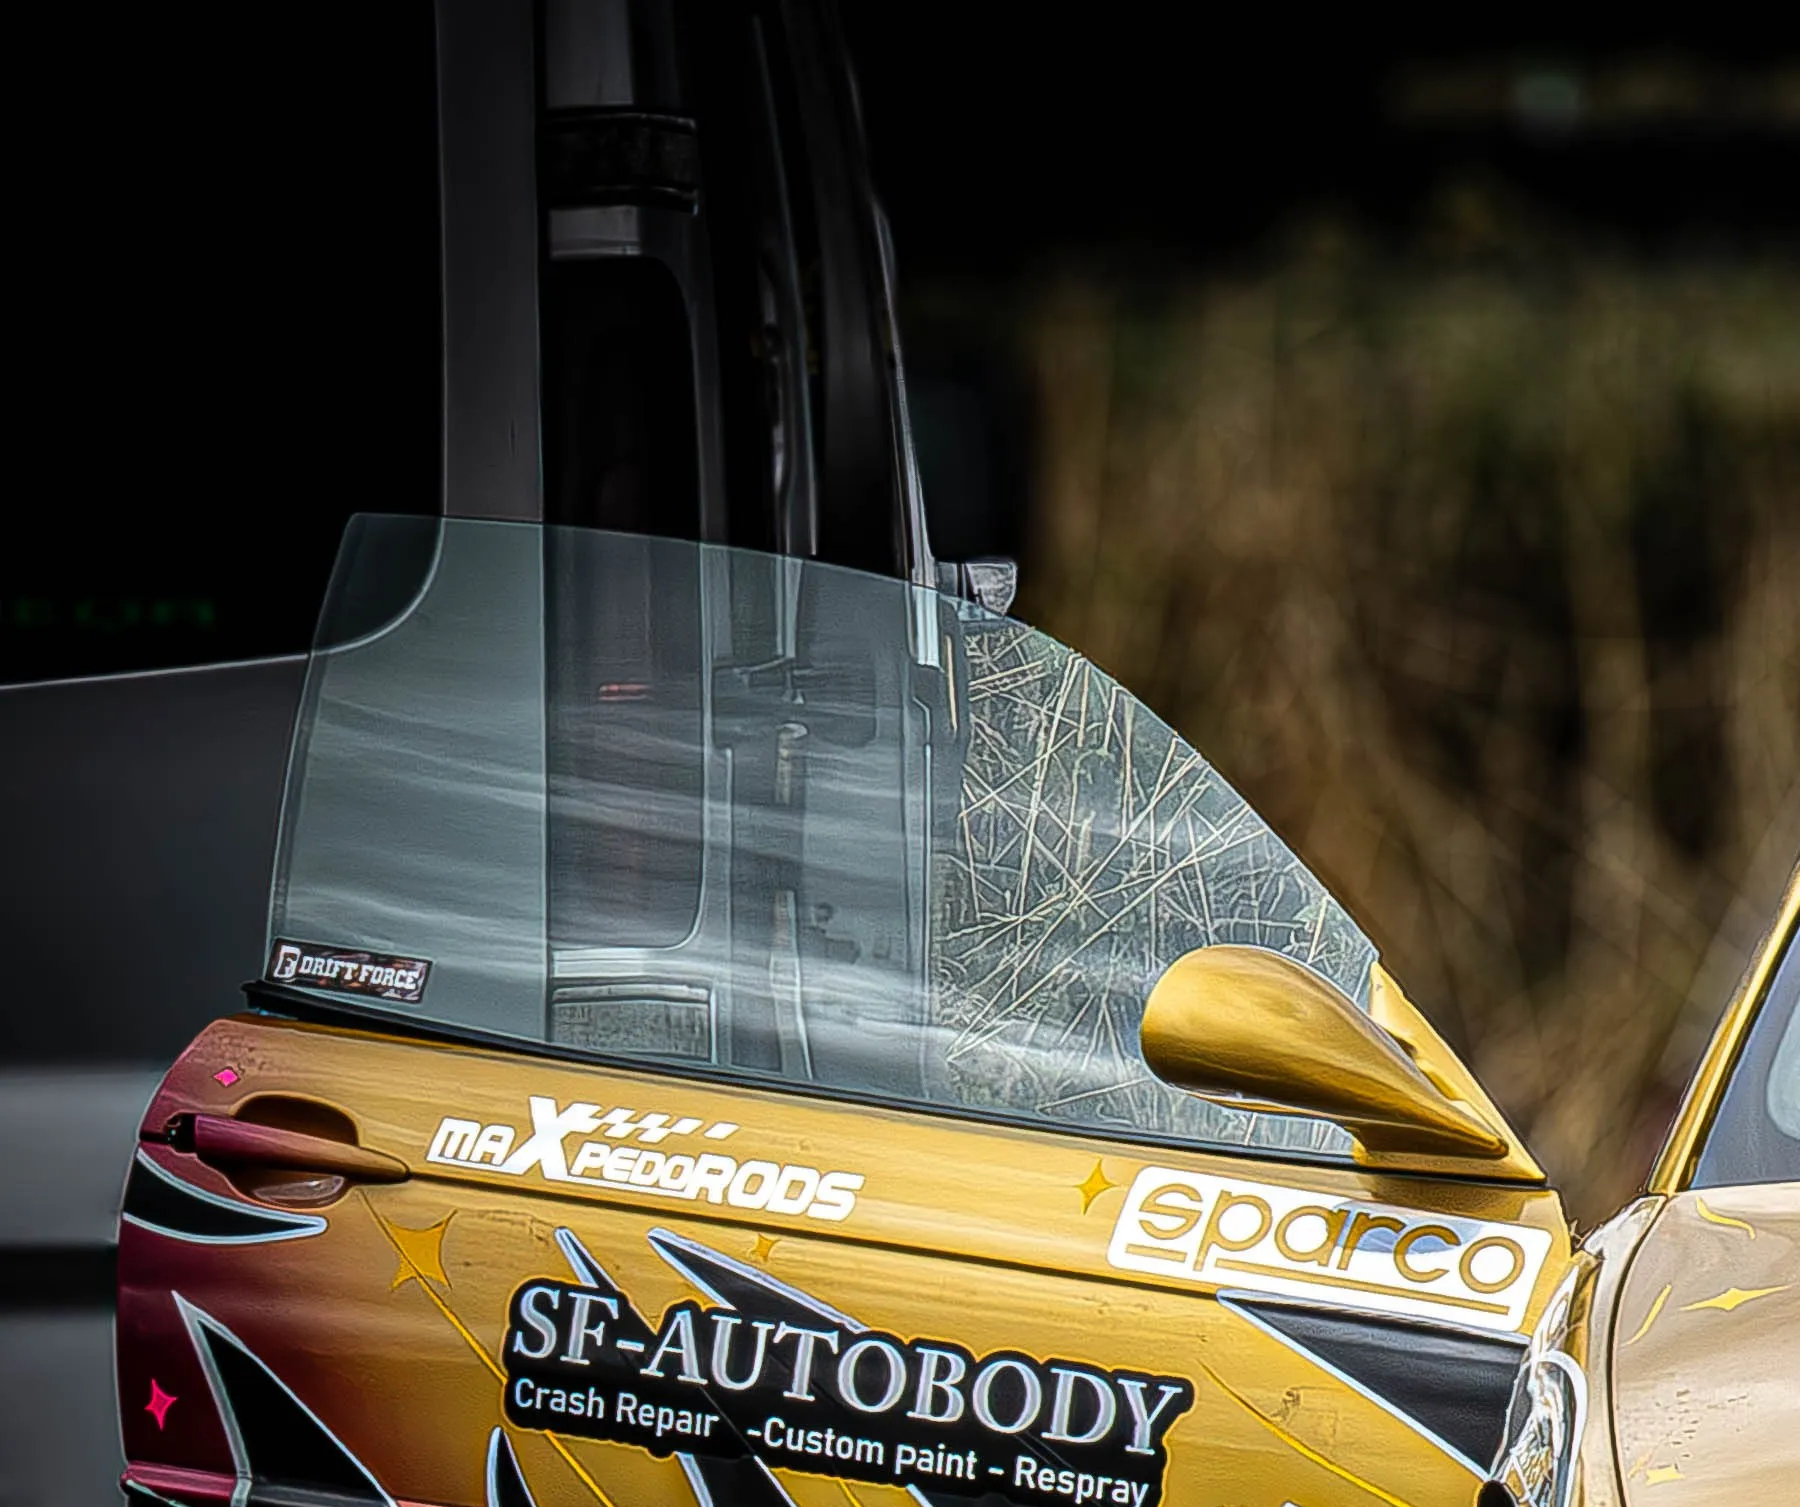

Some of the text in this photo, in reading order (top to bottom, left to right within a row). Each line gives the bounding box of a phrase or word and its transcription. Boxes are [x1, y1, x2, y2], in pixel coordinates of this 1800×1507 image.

[298, 955, 358, 981] DRIFT
[358, 964, 420, 990] FORCE
[1137, 1183, 1526, 1294] sparco
[511, 1285, 1183, 1456] SF-AUTOBODY
[514, 1378, 605, 1419] Crash
[615, 1391, 720, 1438] Repair
